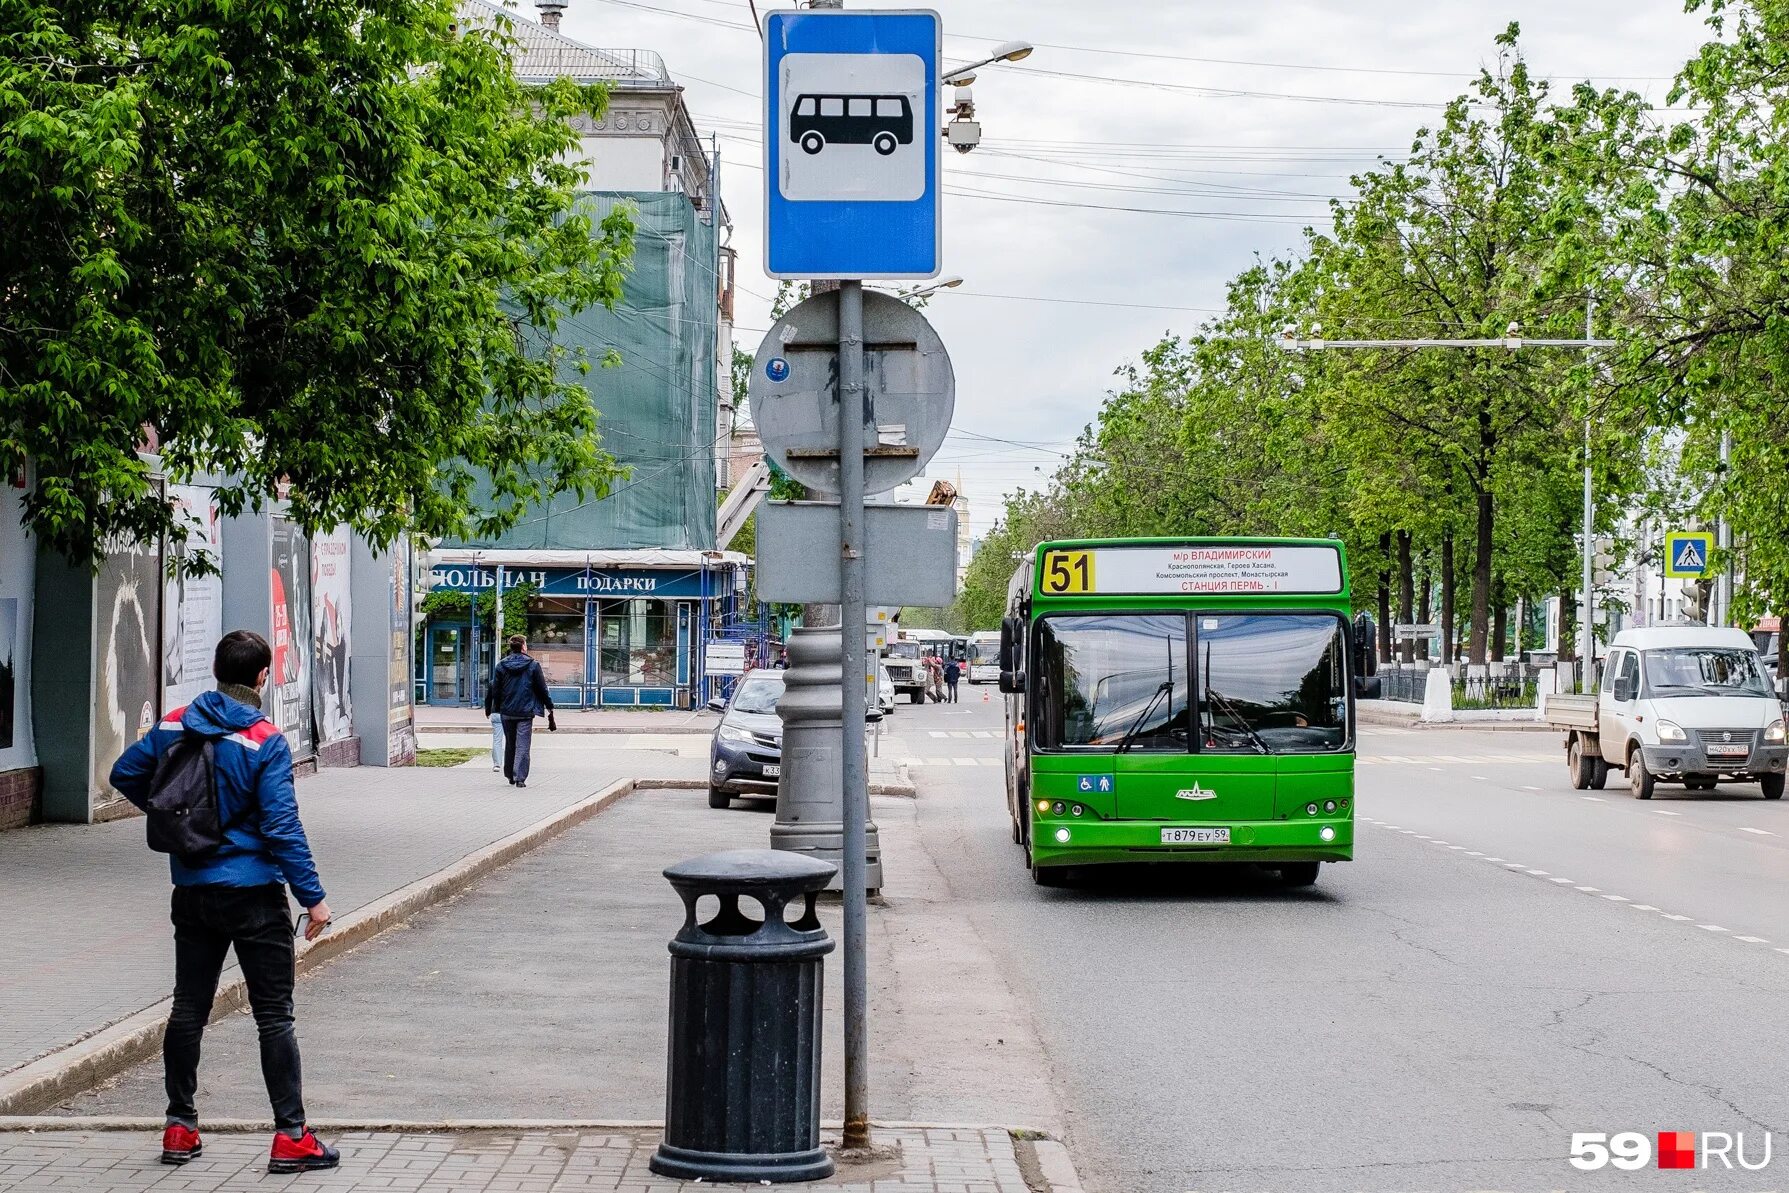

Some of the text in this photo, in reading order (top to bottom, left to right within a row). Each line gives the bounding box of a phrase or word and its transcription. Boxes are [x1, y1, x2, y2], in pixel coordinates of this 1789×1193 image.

[1173, 549, 1271, 562] м/р ВЛАДИМИРСКИЙ
[1050, 554, 1089, 592] 51
[577, 577, 657, 592] ПОДАРКИ
[1181, 582, 1229, 591] СТАНЦИЯ
[1230, 581, 1264, 590] ПЕРМЬ
[1166, 829, 1226, 841] Т879ЕУ 59
